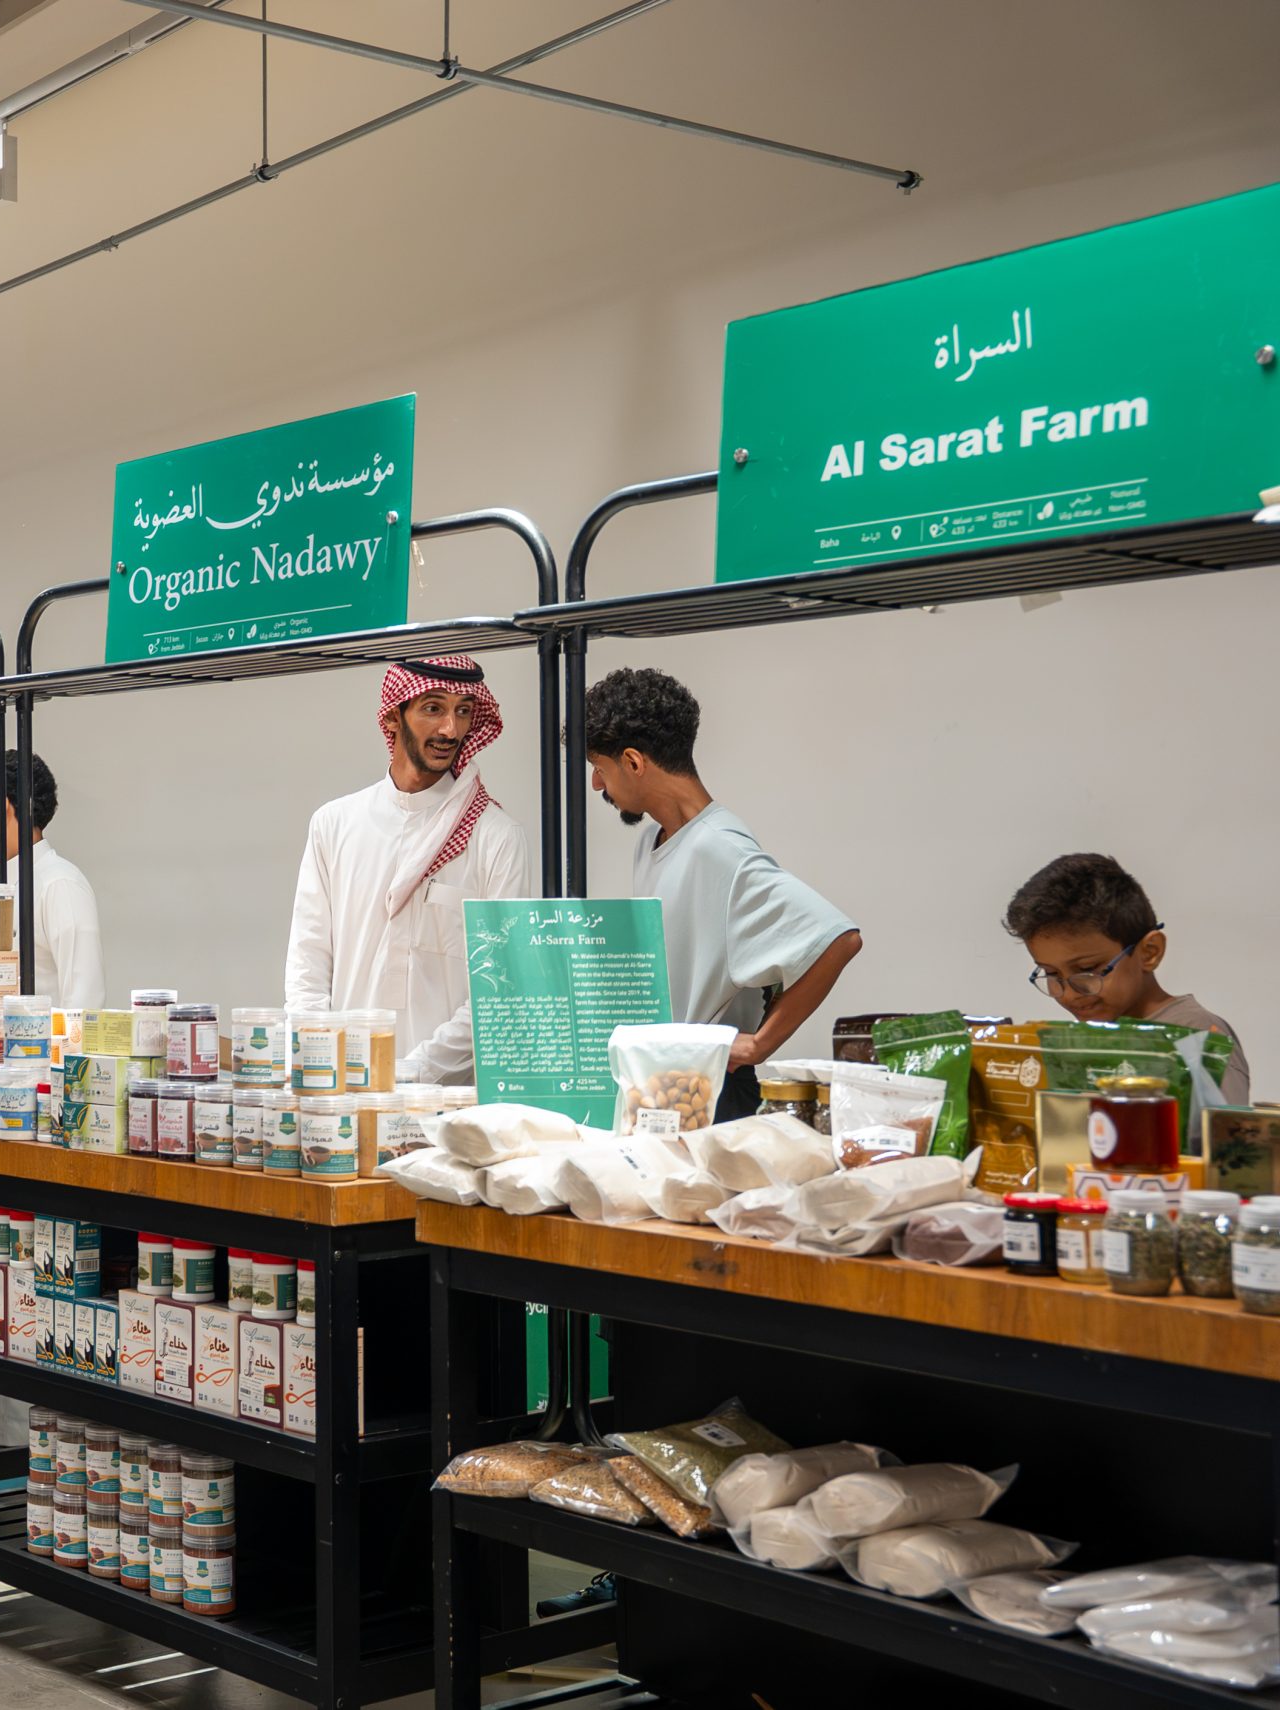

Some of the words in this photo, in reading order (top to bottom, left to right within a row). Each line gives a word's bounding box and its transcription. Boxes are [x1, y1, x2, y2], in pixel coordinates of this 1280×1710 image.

[934, 307, 1032, 382] السراة
[820, 440, 865, 482] Al
[879, 415, 1003, 472] Sarat
[1019, 397, 1149, 449] Farm
[308, 452, 395, 497] مؤسسة
[205, 462, 305, 530] ندوي
[133, 483, 204, 552] العضوية
[820, 538, 840, 549] Baha
[128, 553, 241, 611] Organic
[250, 533, 383, 582] Nadawy
[529, 910, 563, 928] السراة
[567, 911, 604, 928] مزرعة
[529, 934, 575, 945] Al-Sarra
[578, 934, 606, 945] Farm
[132, 1320, 151, 1334] حناء
[169, 1335, 188, 1350] حناء
[209, 1337, 230, 1353] حناء
[255, 1354, 276, 1370] حناء
[300, 1355, 316, 1372] ناء
